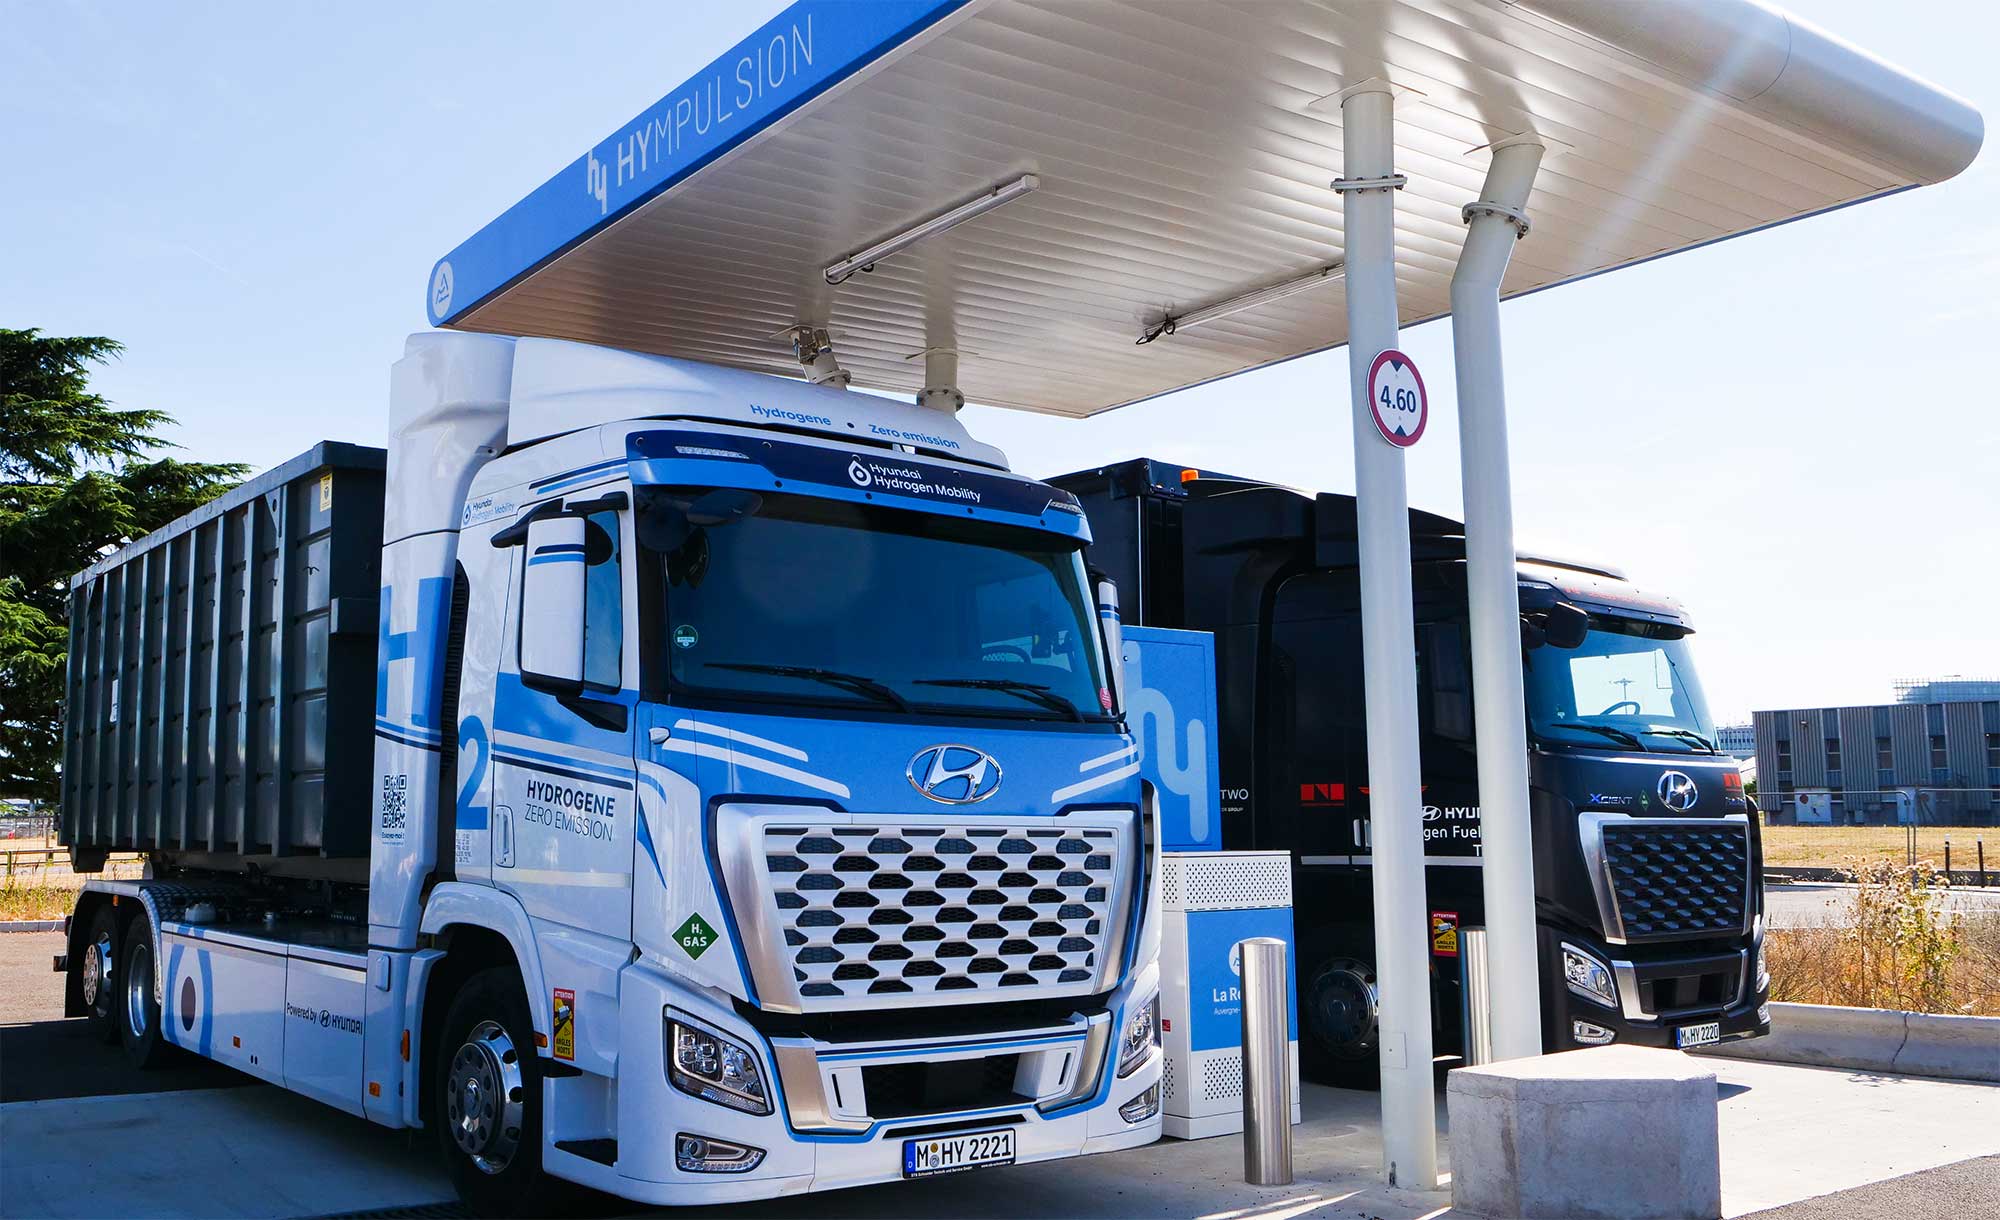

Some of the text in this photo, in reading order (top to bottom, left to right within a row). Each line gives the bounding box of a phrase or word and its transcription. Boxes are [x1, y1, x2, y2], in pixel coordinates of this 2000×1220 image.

[616, 14, 814, 187] HYMPULSION
[1380, 384, 1417, 413] 4.60
[750, 403, 960, 450] Hydrogene Zero emission
[869, 463, 922, 480] Hyundai
[874, 475, 982, 503] Hydrogen Mobility
[526, 779, 616, 818] HYDROGENE
[1589, 793, 1633, 805] XCIENT
[524, 803, 613, 842] ZERO EMISSION
[1453, 825, 1481, 838] Fuel
[683, 936, 707, 947] GAS
[1213, 988, 1227, 1003] La
[286, 1002, 364, 1036] Powered by HYUNDAI
[1680, 1029, 1686, 1045] M
[1690, 1027, 1700, 1043] HY
[916, 1144, 929, 1168] M
[941, 1140, 965, 1165] HY
[969, 1134, 1011, 1161] 2221
